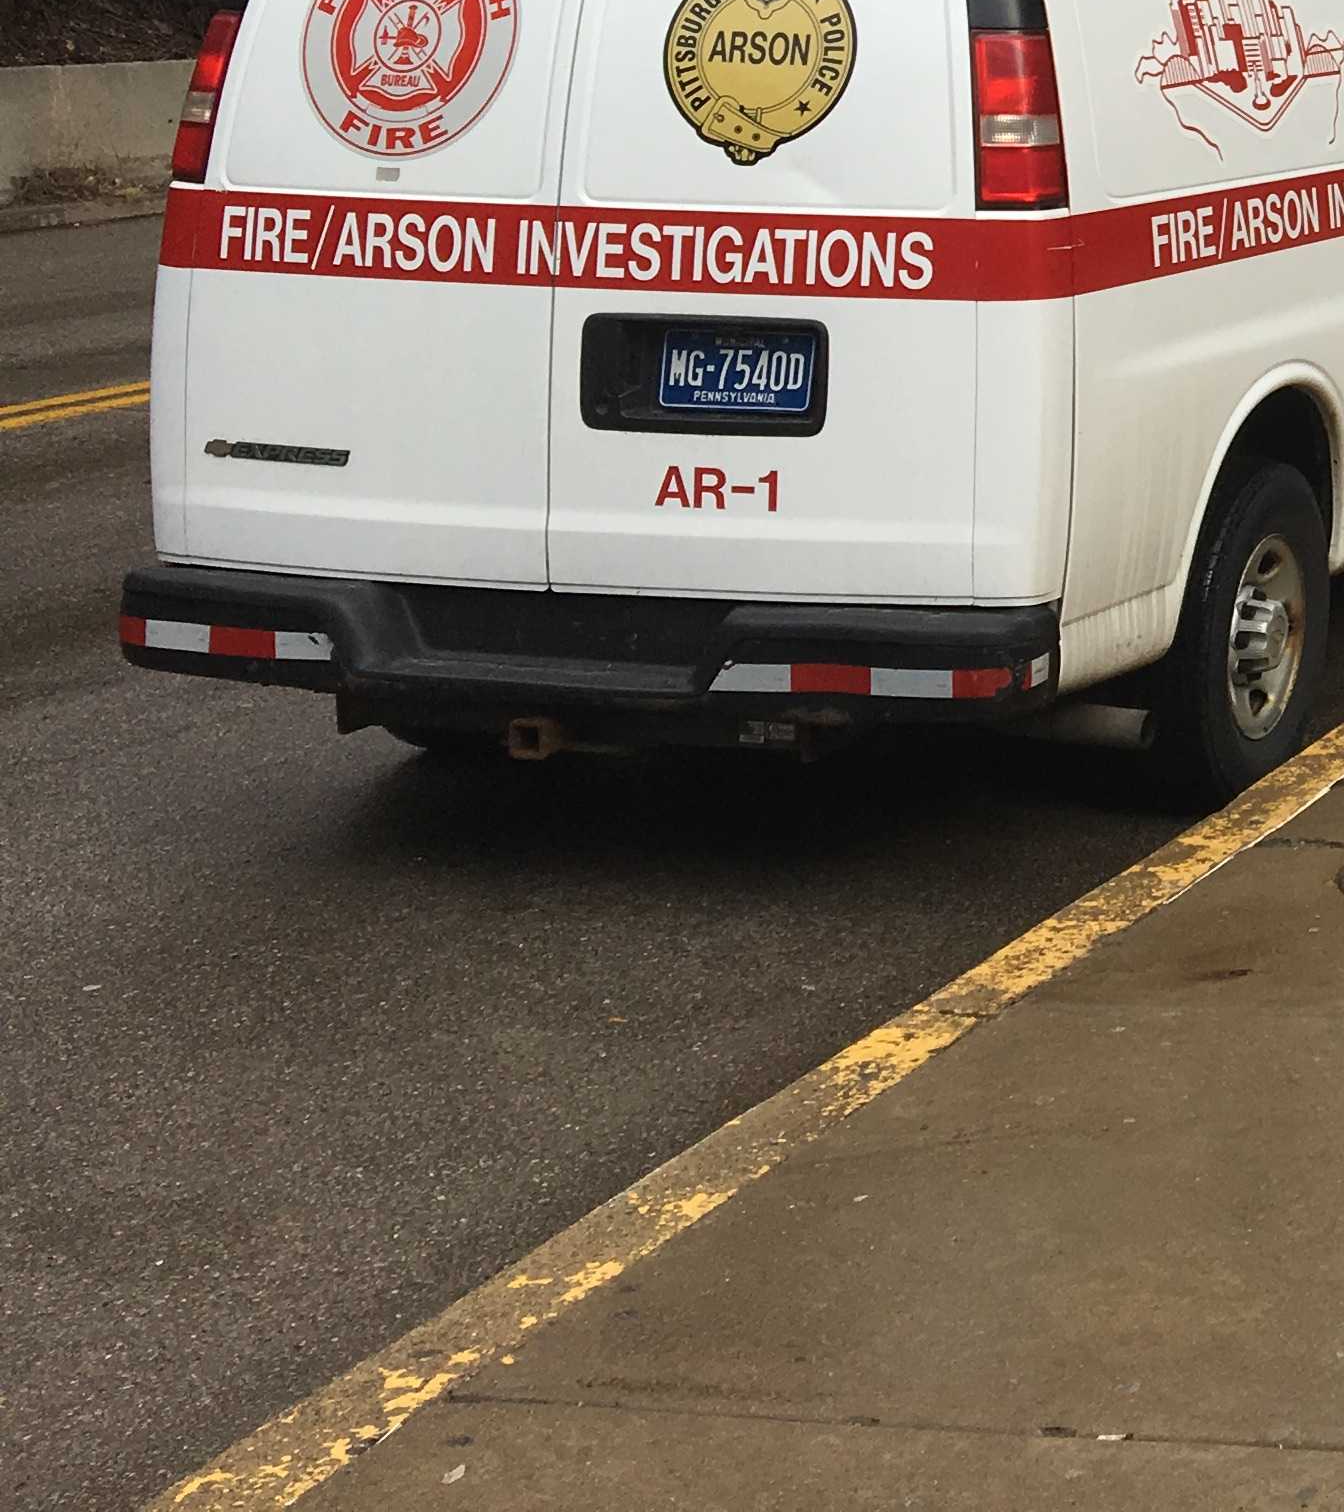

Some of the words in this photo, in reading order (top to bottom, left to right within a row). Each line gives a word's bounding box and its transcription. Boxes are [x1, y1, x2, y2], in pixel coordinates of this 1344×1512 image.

[707, 30, 812, 66] ARSON
[810, 12, 846, 97] POLICE
[380, 74, 420, 88] BUREAU
[338, 109, 449, 150] FIRE
[220, 205, 496, 274] FIRE/ARSON
[517, 219, 934, 290] INVESTIGATIONS
[1151, 187, 1320, 268] FIRE/ARSON
[669, 349, 805, 391] MG-7540D
[693, 390, 775, 404] PENNSYLVANIA
[233, 442, 349, 466] EXPRESS
[655, 465, 778, 512] AR-1
